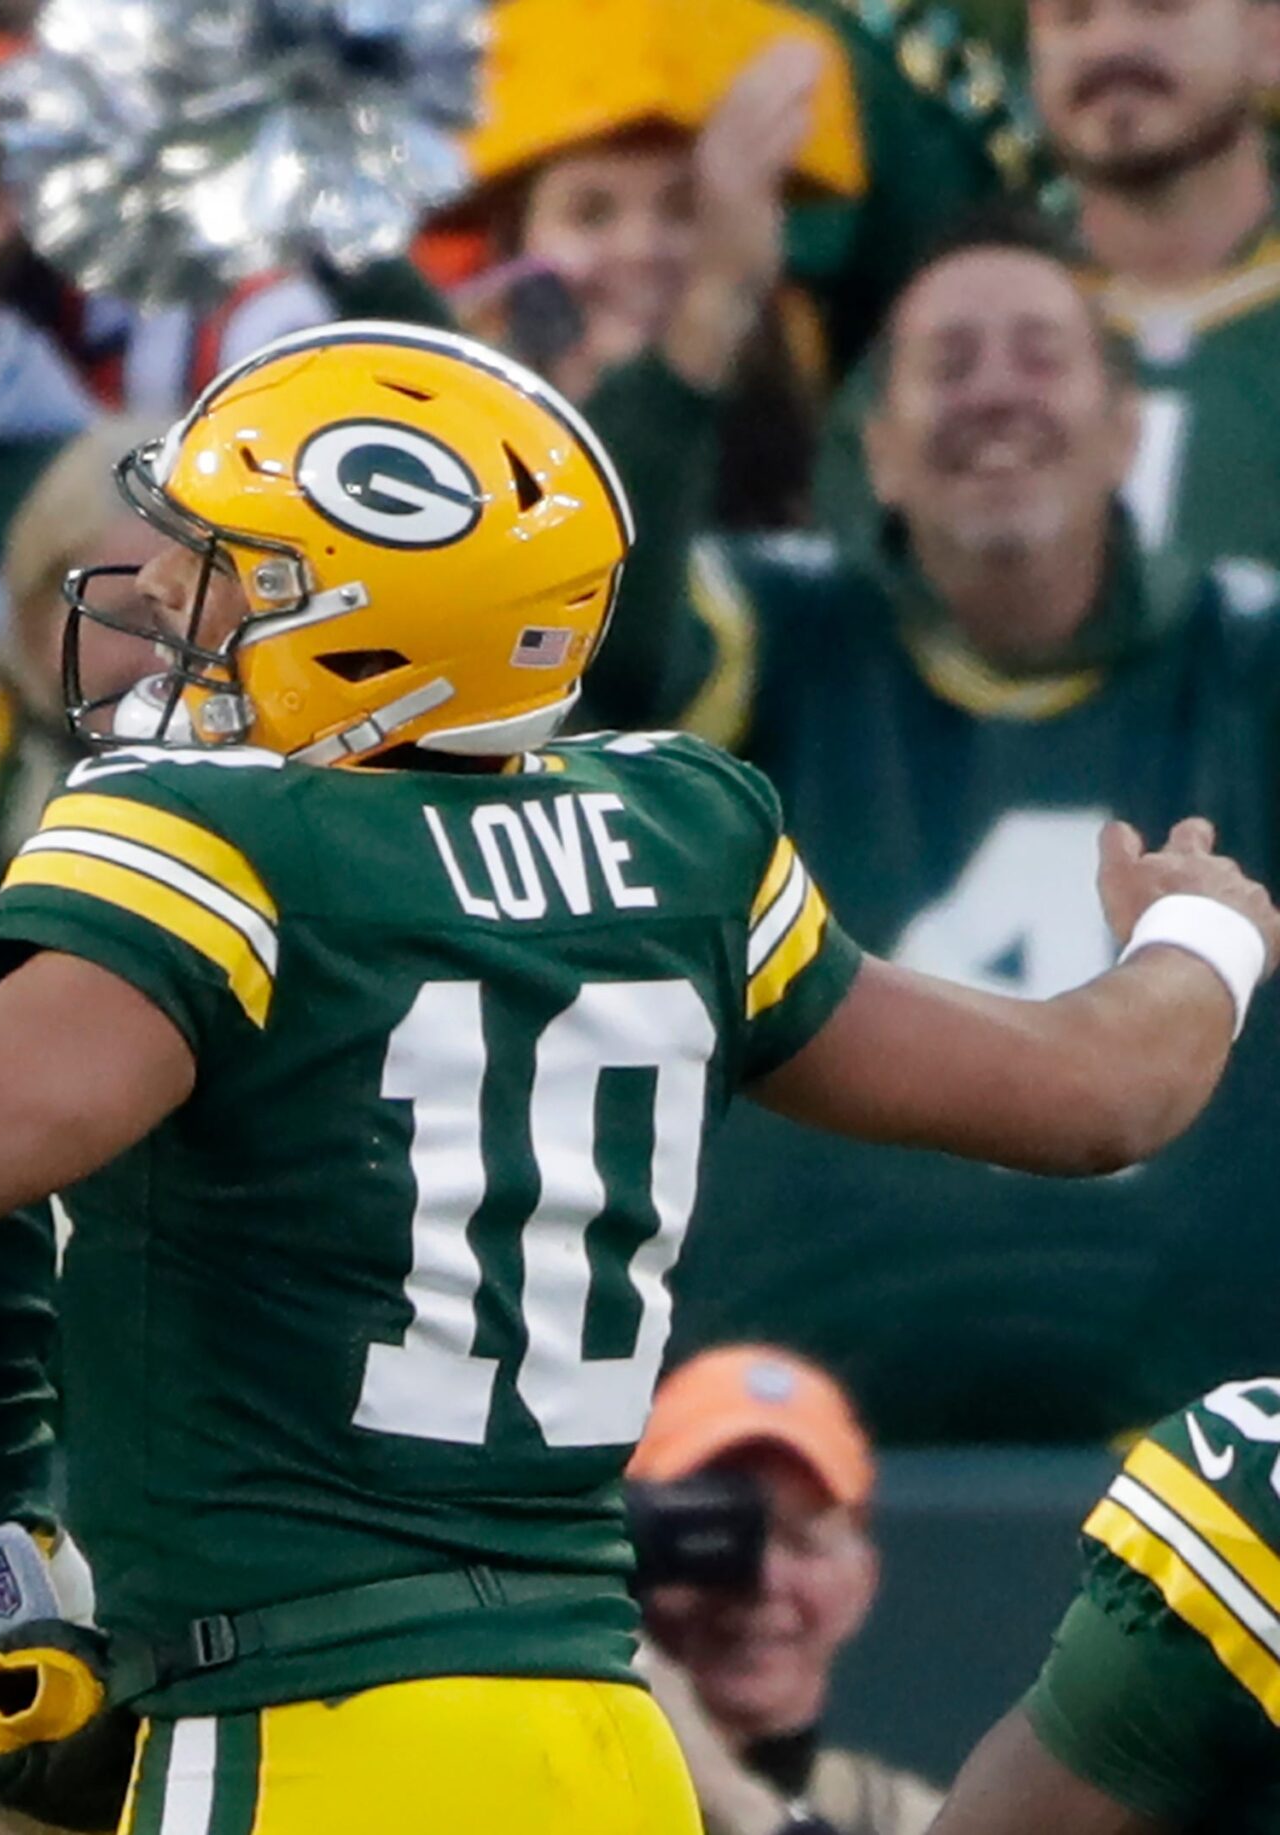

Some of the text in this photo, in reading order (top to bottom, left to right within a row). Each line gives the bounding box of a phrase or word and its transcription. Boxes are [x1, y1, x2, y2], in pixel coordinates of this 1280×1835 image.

[295, 420, 480, 547] G
[422, 792, 658, 920] LOVE
[352, 979, 717, 1447] 10
